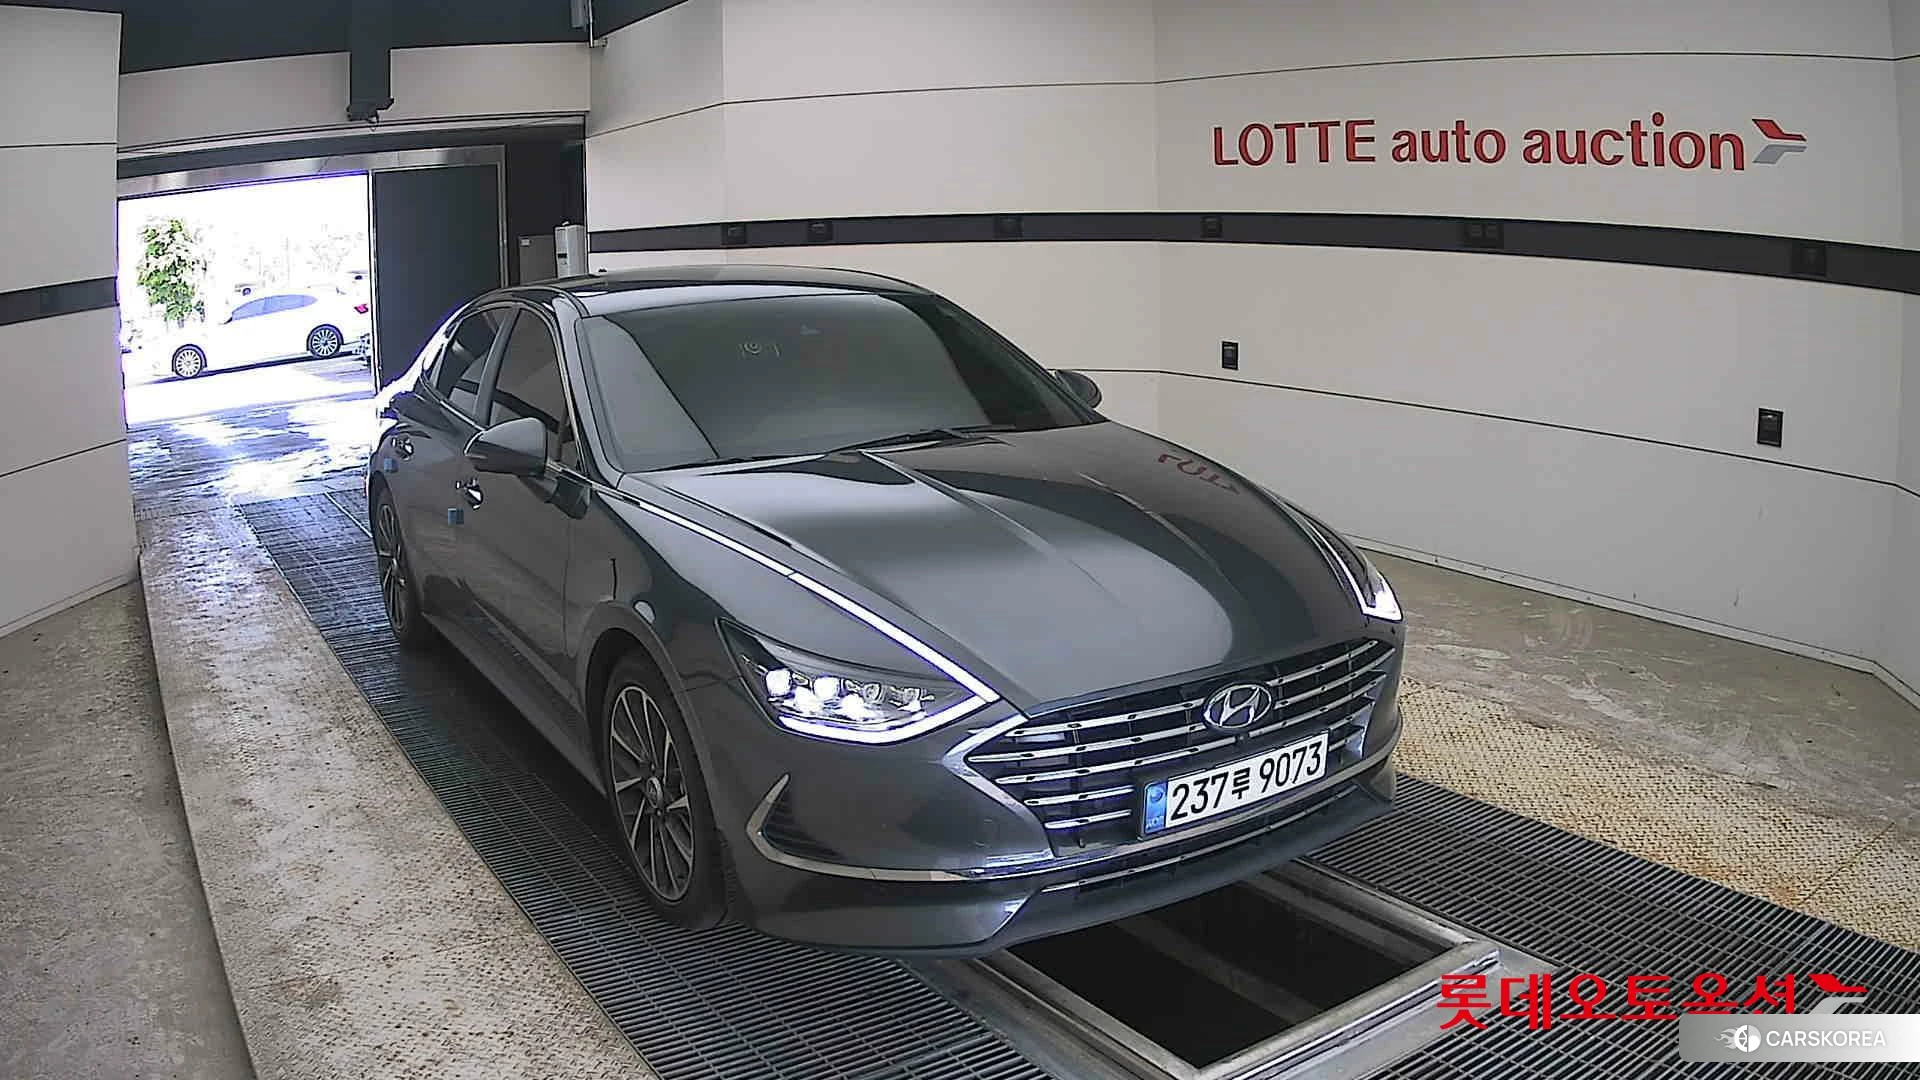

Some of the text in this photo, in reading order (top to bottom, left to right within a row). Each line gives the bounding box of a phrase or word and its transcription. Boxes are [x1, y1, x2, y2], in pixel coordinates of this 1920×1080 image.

[1213, 111, 1746, 171] LOTTE auto auction
[1170, 740, 1324, 822] 237루 9073
